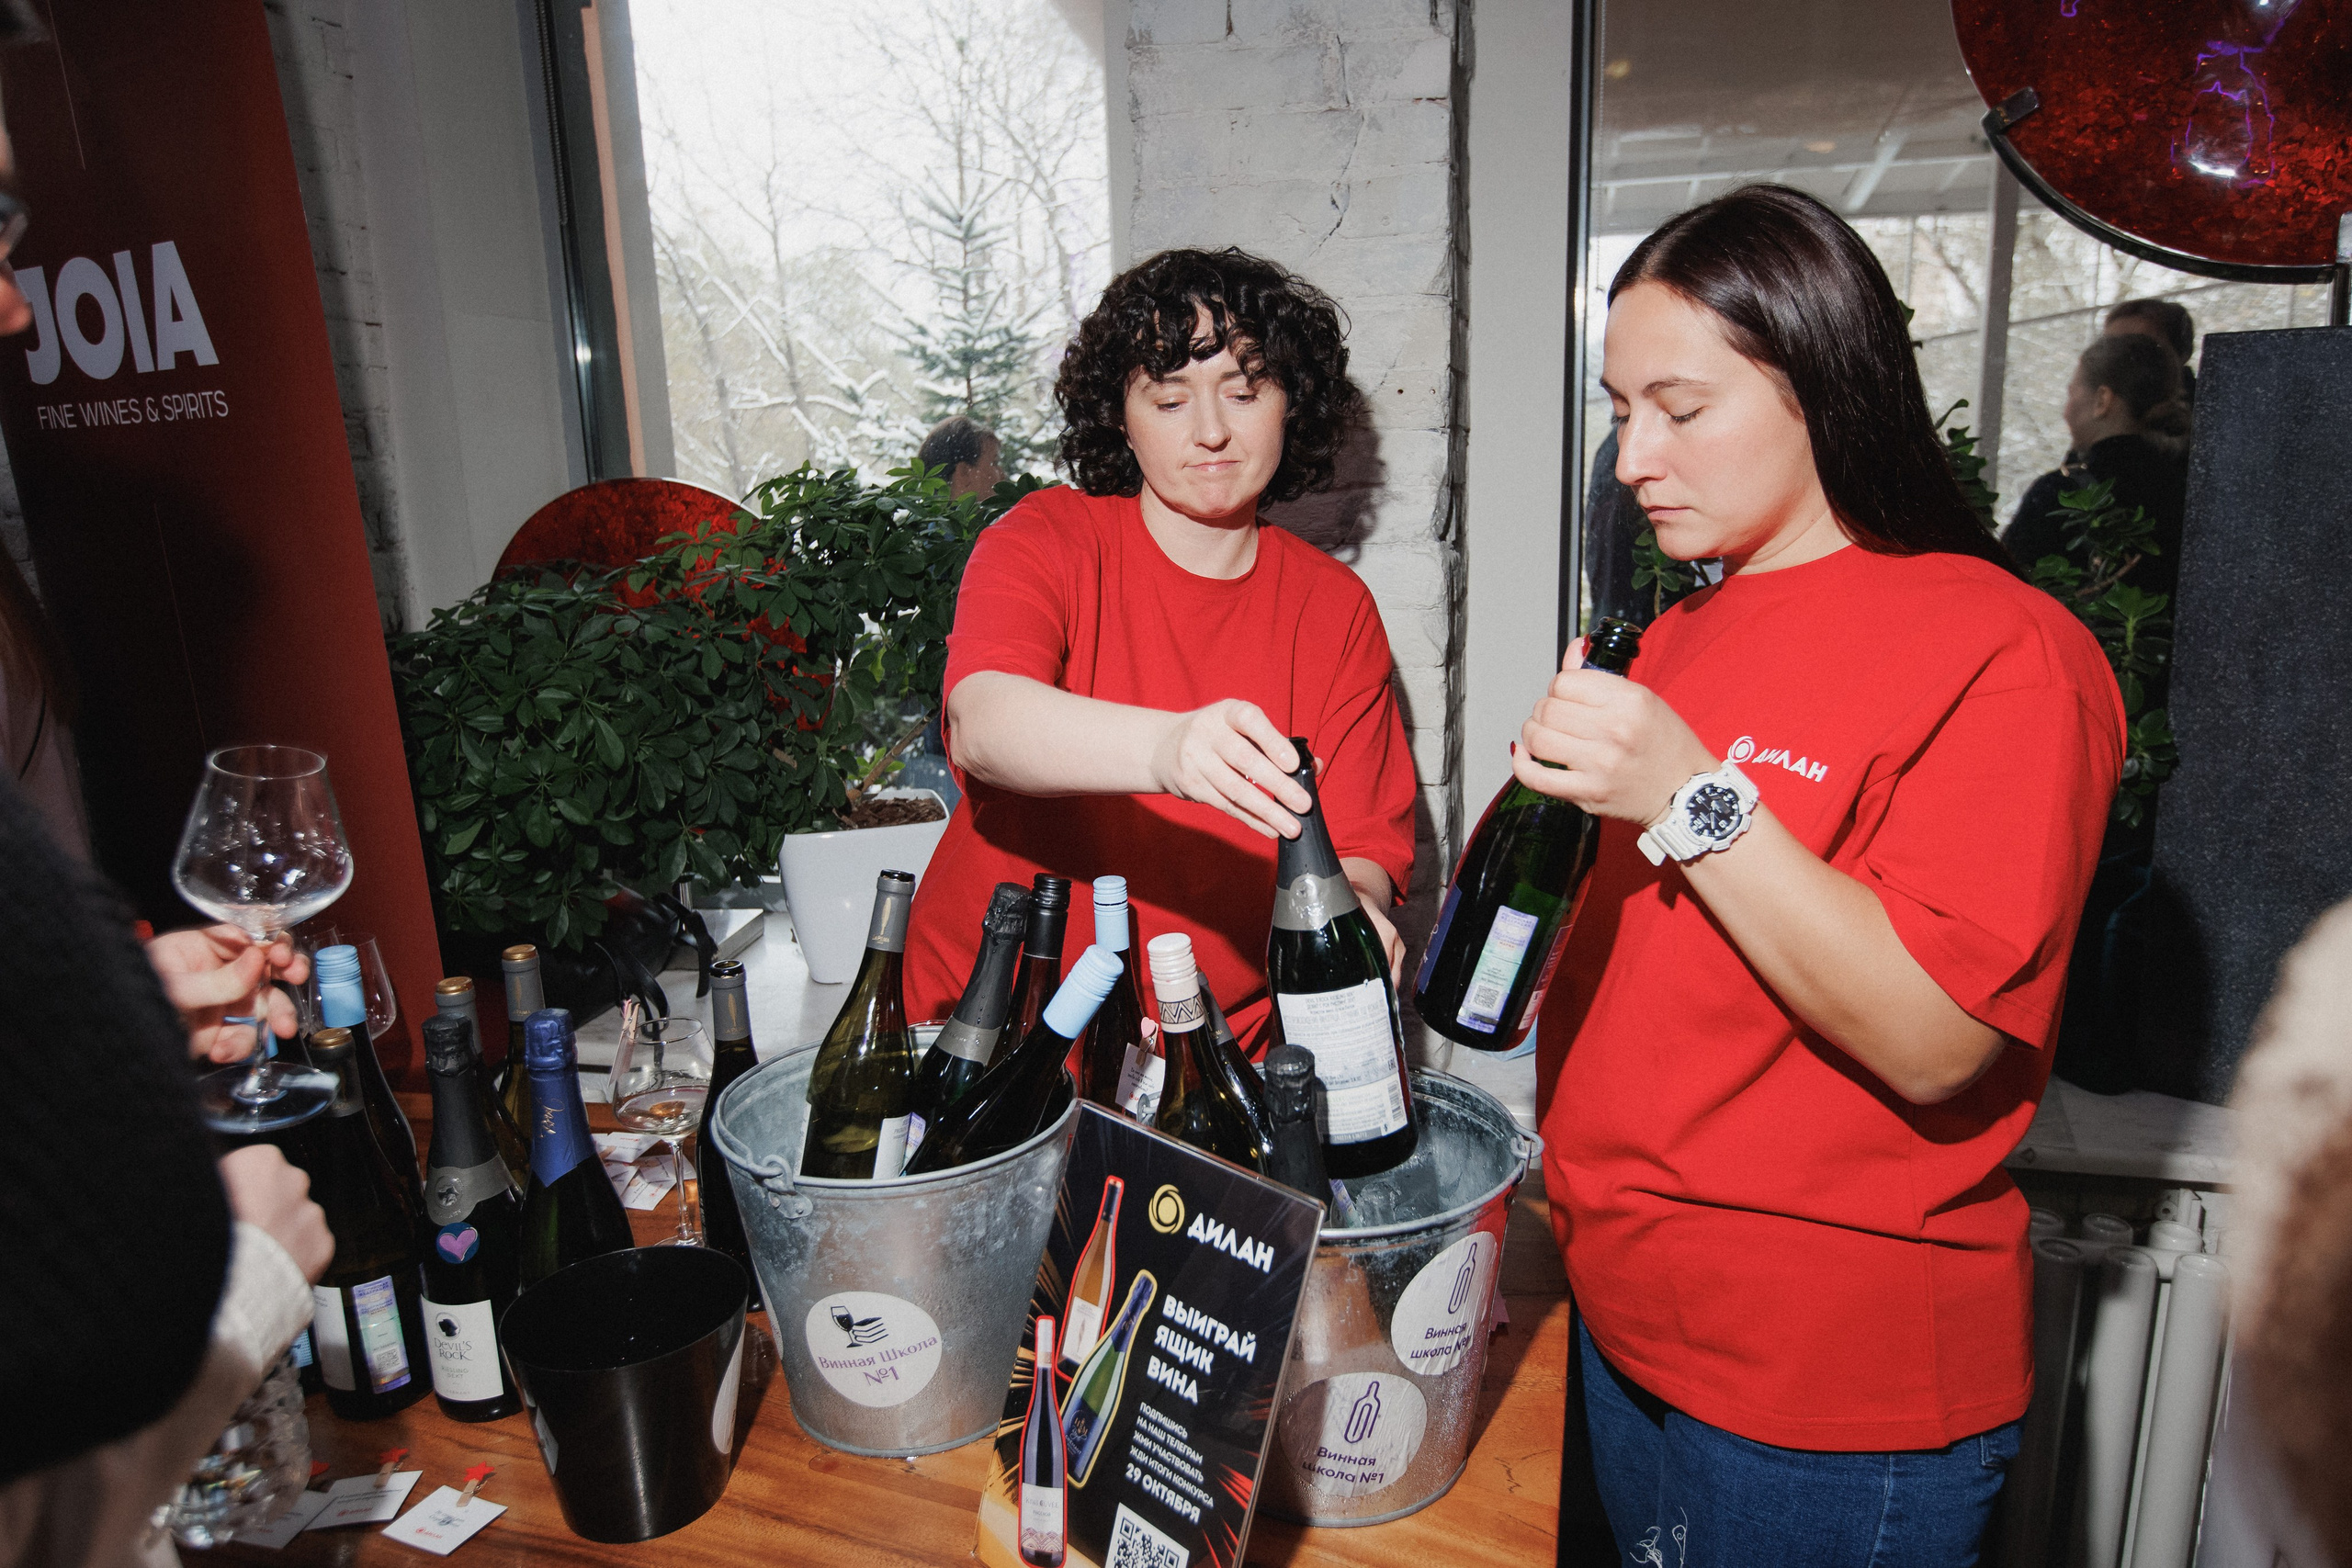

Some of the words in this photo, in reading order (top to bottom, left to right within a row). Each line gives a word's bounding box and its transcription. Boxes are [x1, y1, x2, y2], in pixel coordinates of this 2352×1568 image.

[14, 241, 220, 384] JOIA
[38, 404, 77, 429] FINE
[79, 399, 141, 426] WINES
[146, 397, 160, 423] &
[162, 390, 229, 421] SPIRITS
[1752, 748, 1828, 783] ДИЛАН
[1187, 1213, 1273, 1273] ДИЛАН
[1155, 1325, 1214, 1374] ЯЩИК
[1163, 1294, 1256, 1363] ВЫИГРАЙ
[1425, 1323, 1467, 1339] Винная
[818, 1356, 876, 1369] Винная
[878, 1337, 938, 1363] Школа
[1410, 1346, 1452, 1359] школа
[863, 1366, 900, 1386] №1
[1148, 1355, 1198, 1404] ВИНА
[1136, 1416, 1147, 1429] НА
[1148, 1423, 1166, 1440] НАШ
[1166, 1434, 1203, 1464] ТЕЛЕГРАМ
[1140, 1402, 1188, 1438] ПОДПИШИСЬ
[1129, 1445, 1148, 1463] ЖДИ
[1148, 1458, 1172, 1480] ИТОГИ
[1172, 1473, 1214, 1507] КОНКУРСА
[1133, 1430, 1152, 1450] ЖМИ
[1152, 1442, 1204, 1483] УЧАСТВОВАТЬ
[1302, 1461, 1356, 1483] школа
[1360, 1472, 1385, 1483] №1
[1317, 1446, 1376, 1466] Винная
[1125, 1462, 1142, 1483] 29
[1142, 1474, 1200, 1524] ОКТЯБРЯ
